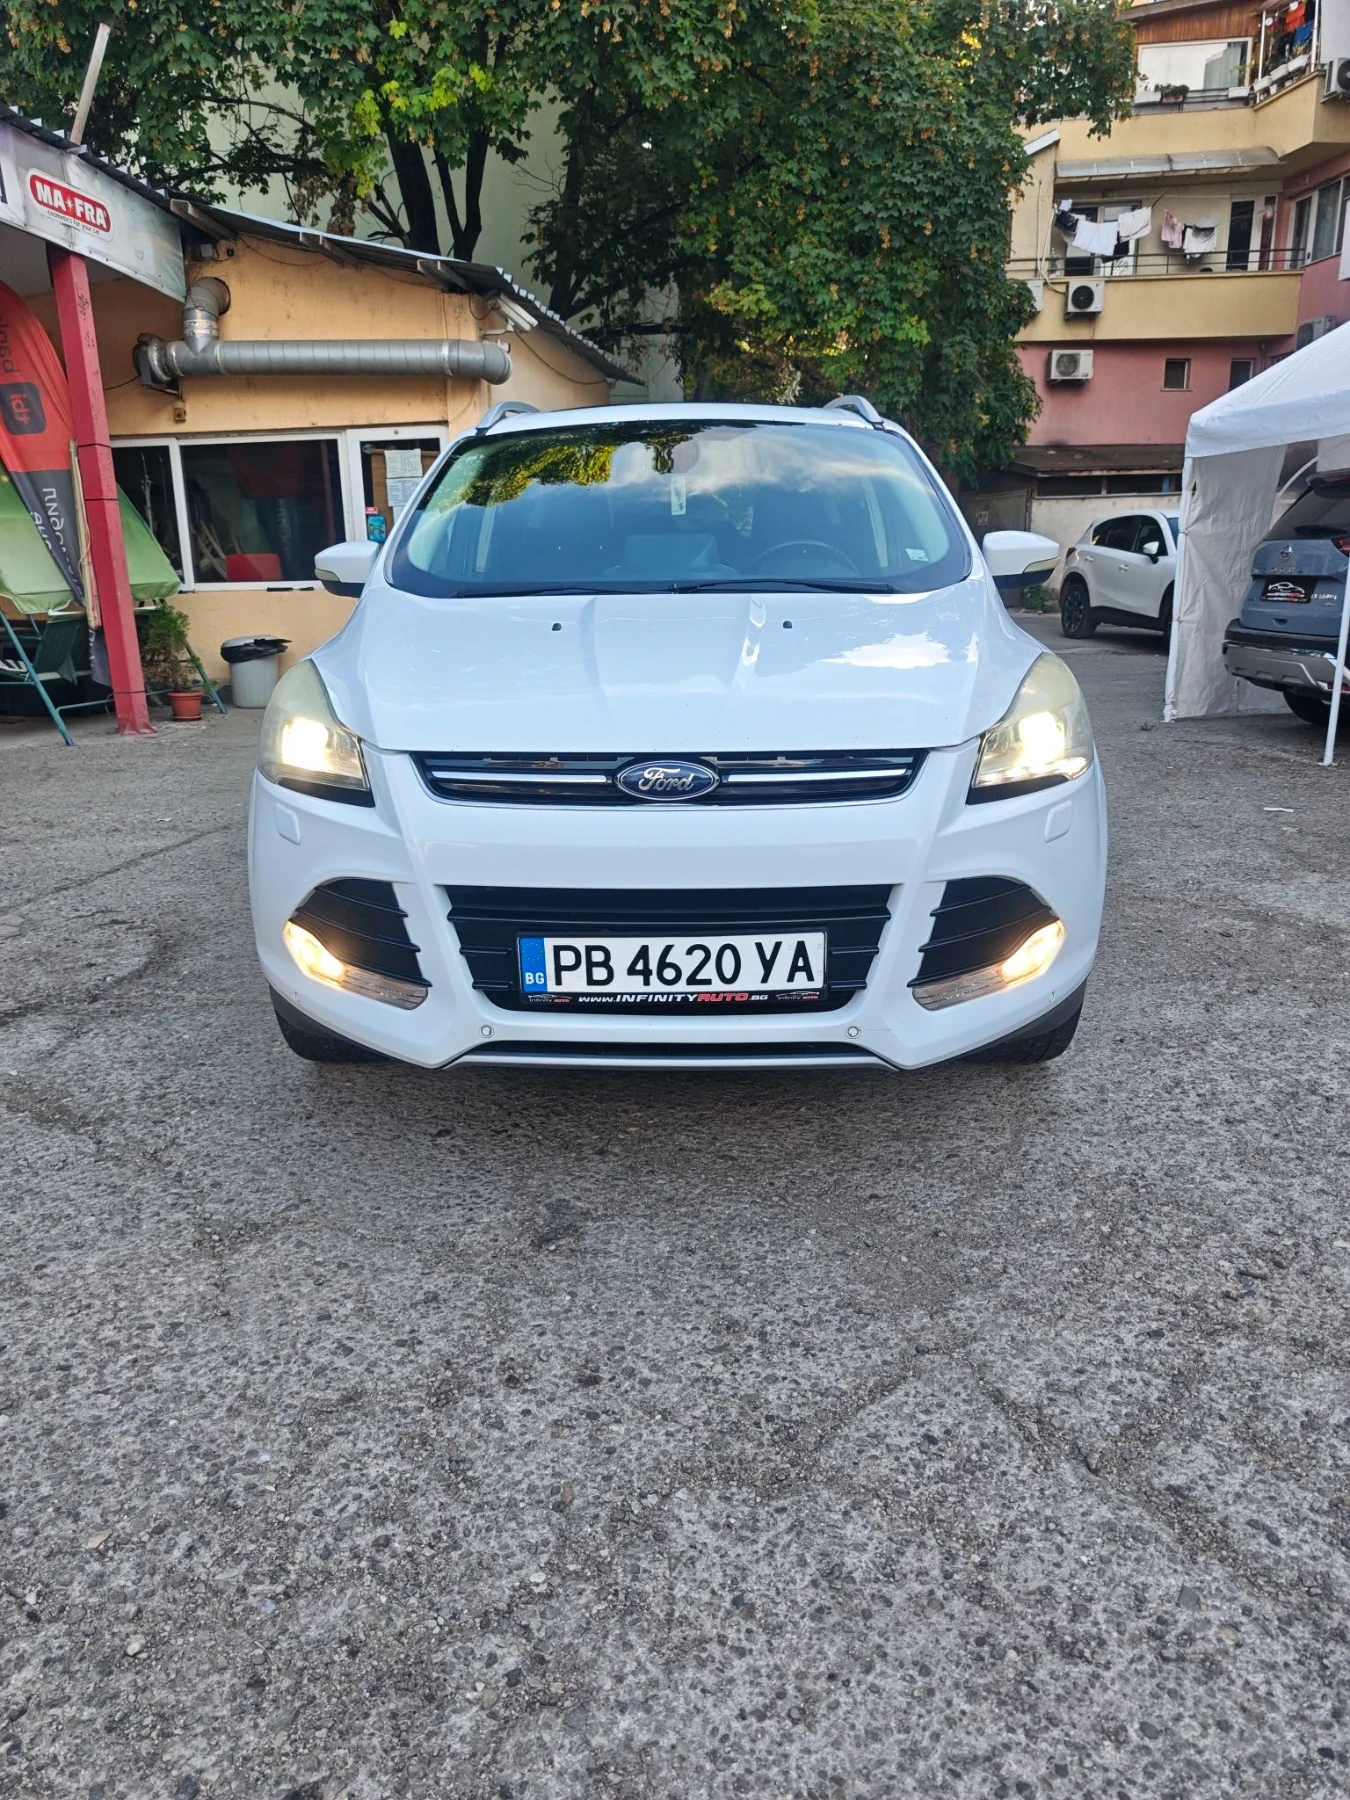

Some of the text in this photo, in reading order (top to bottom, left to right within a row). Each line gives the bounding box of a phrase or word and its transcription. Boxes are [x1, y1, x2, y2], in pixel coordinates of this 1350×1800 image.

[47, 209, 73, 225] cosmetics
[82, 224, 92, 233] your
[638, 766, 695, 791] Ford
[553, 940, 815, 987] PB 4620 YA
[525, 972, 545, 985] BG
